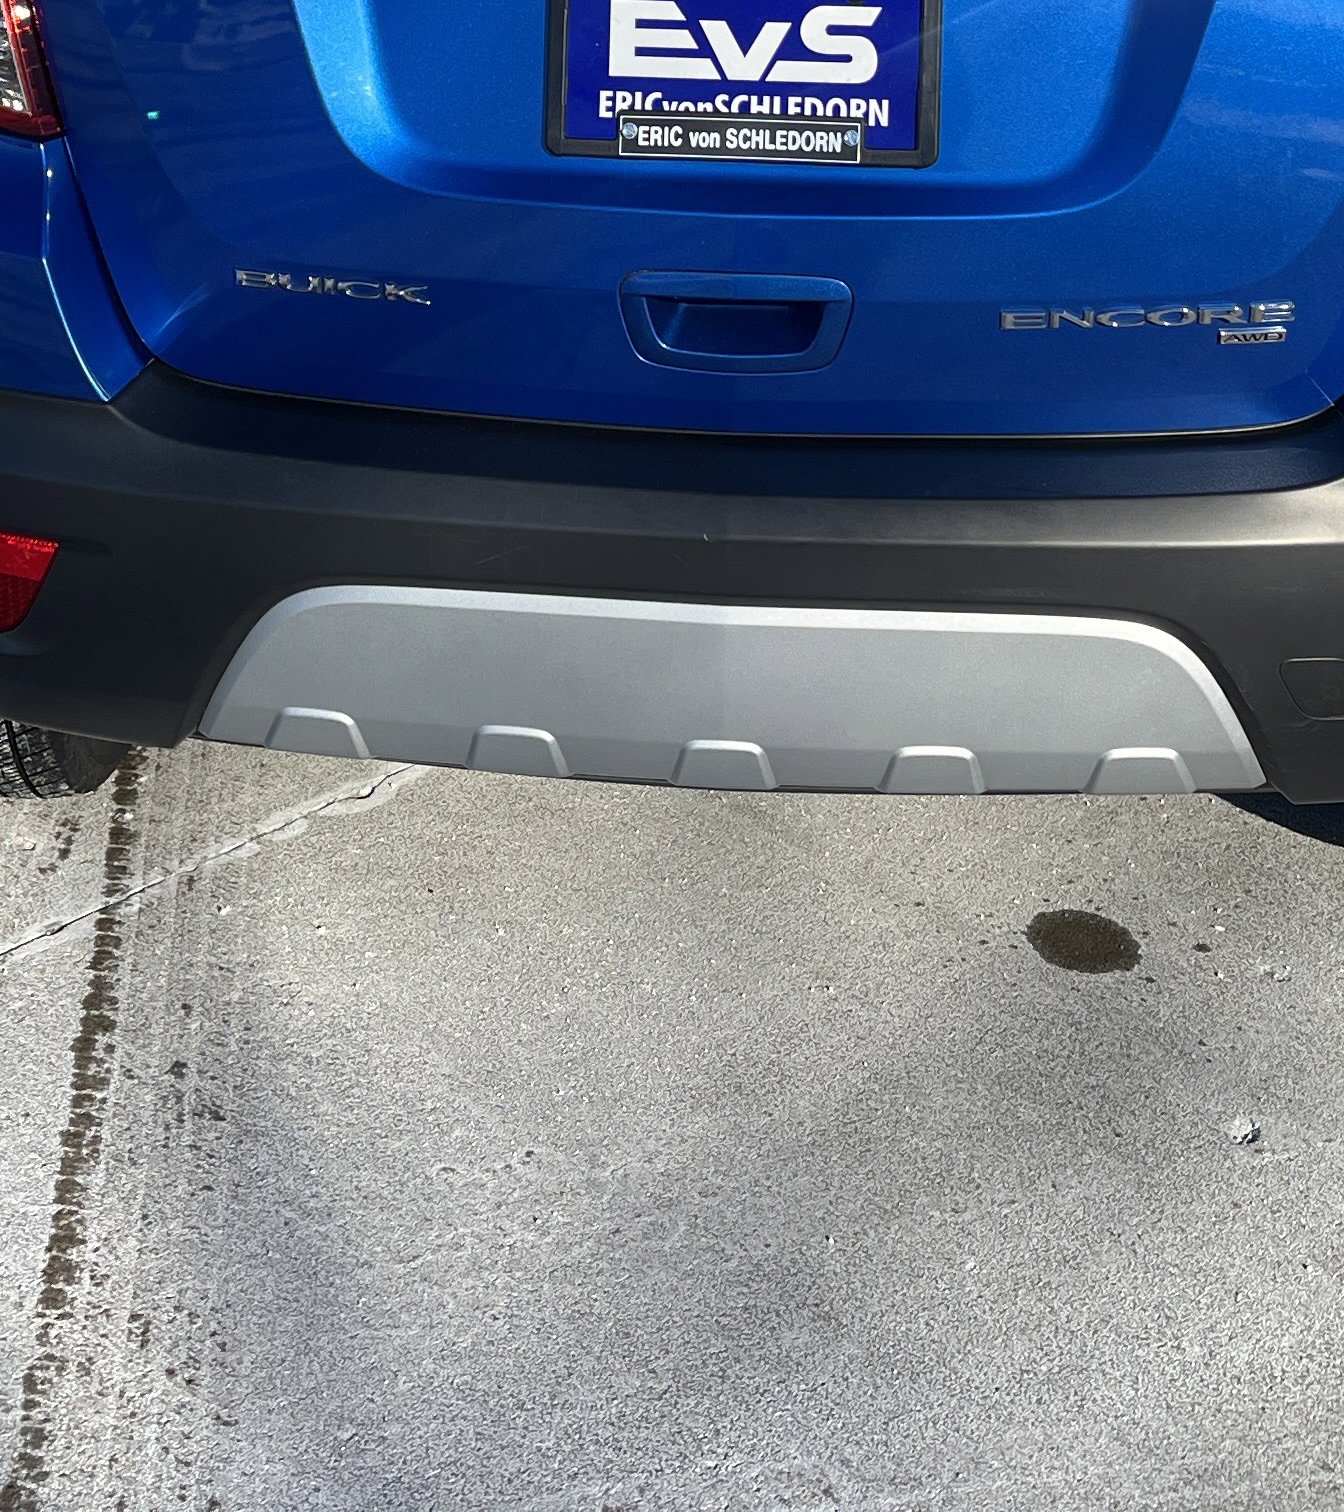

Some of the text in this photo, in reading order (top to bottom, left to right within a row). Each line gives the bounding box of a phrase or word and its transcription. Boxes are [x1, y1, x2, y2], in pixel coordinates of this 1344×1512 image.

[637, 125, 843, 154] ERIC von SCHLEDORN
[234, 268, 432, 306] BUICK
[999, 299, 1296, 330] ENCORE
[1221, 330, 1285, 344] AWD
